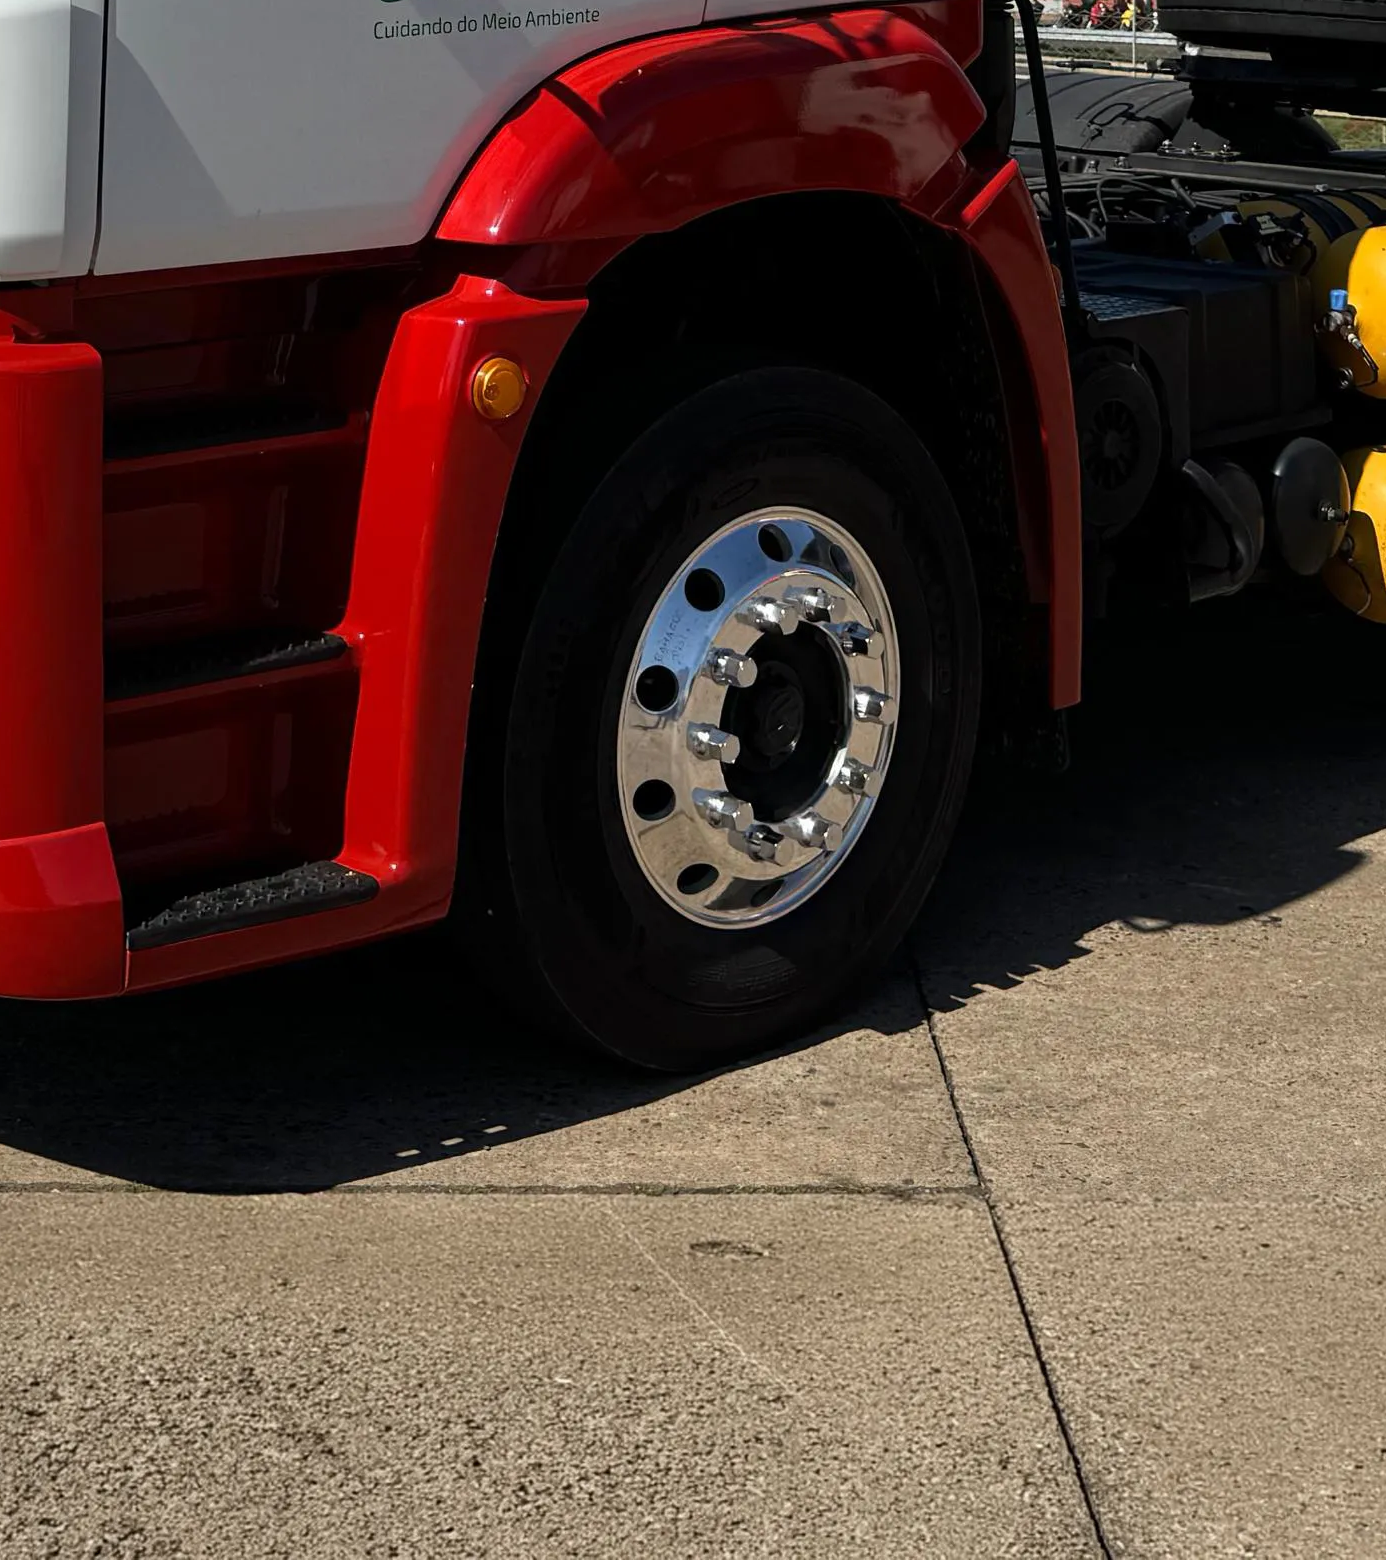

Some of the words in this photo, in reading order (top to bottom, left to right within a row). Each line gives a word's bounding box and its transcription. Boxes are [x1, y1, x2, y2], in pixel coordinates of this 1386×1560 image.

[373, 17, 453, 40] Cuidando
[457, 16, 478, 32] do
[482, 13, 521, 31] Meio
[525, 8, 601, 28] Ambiente
